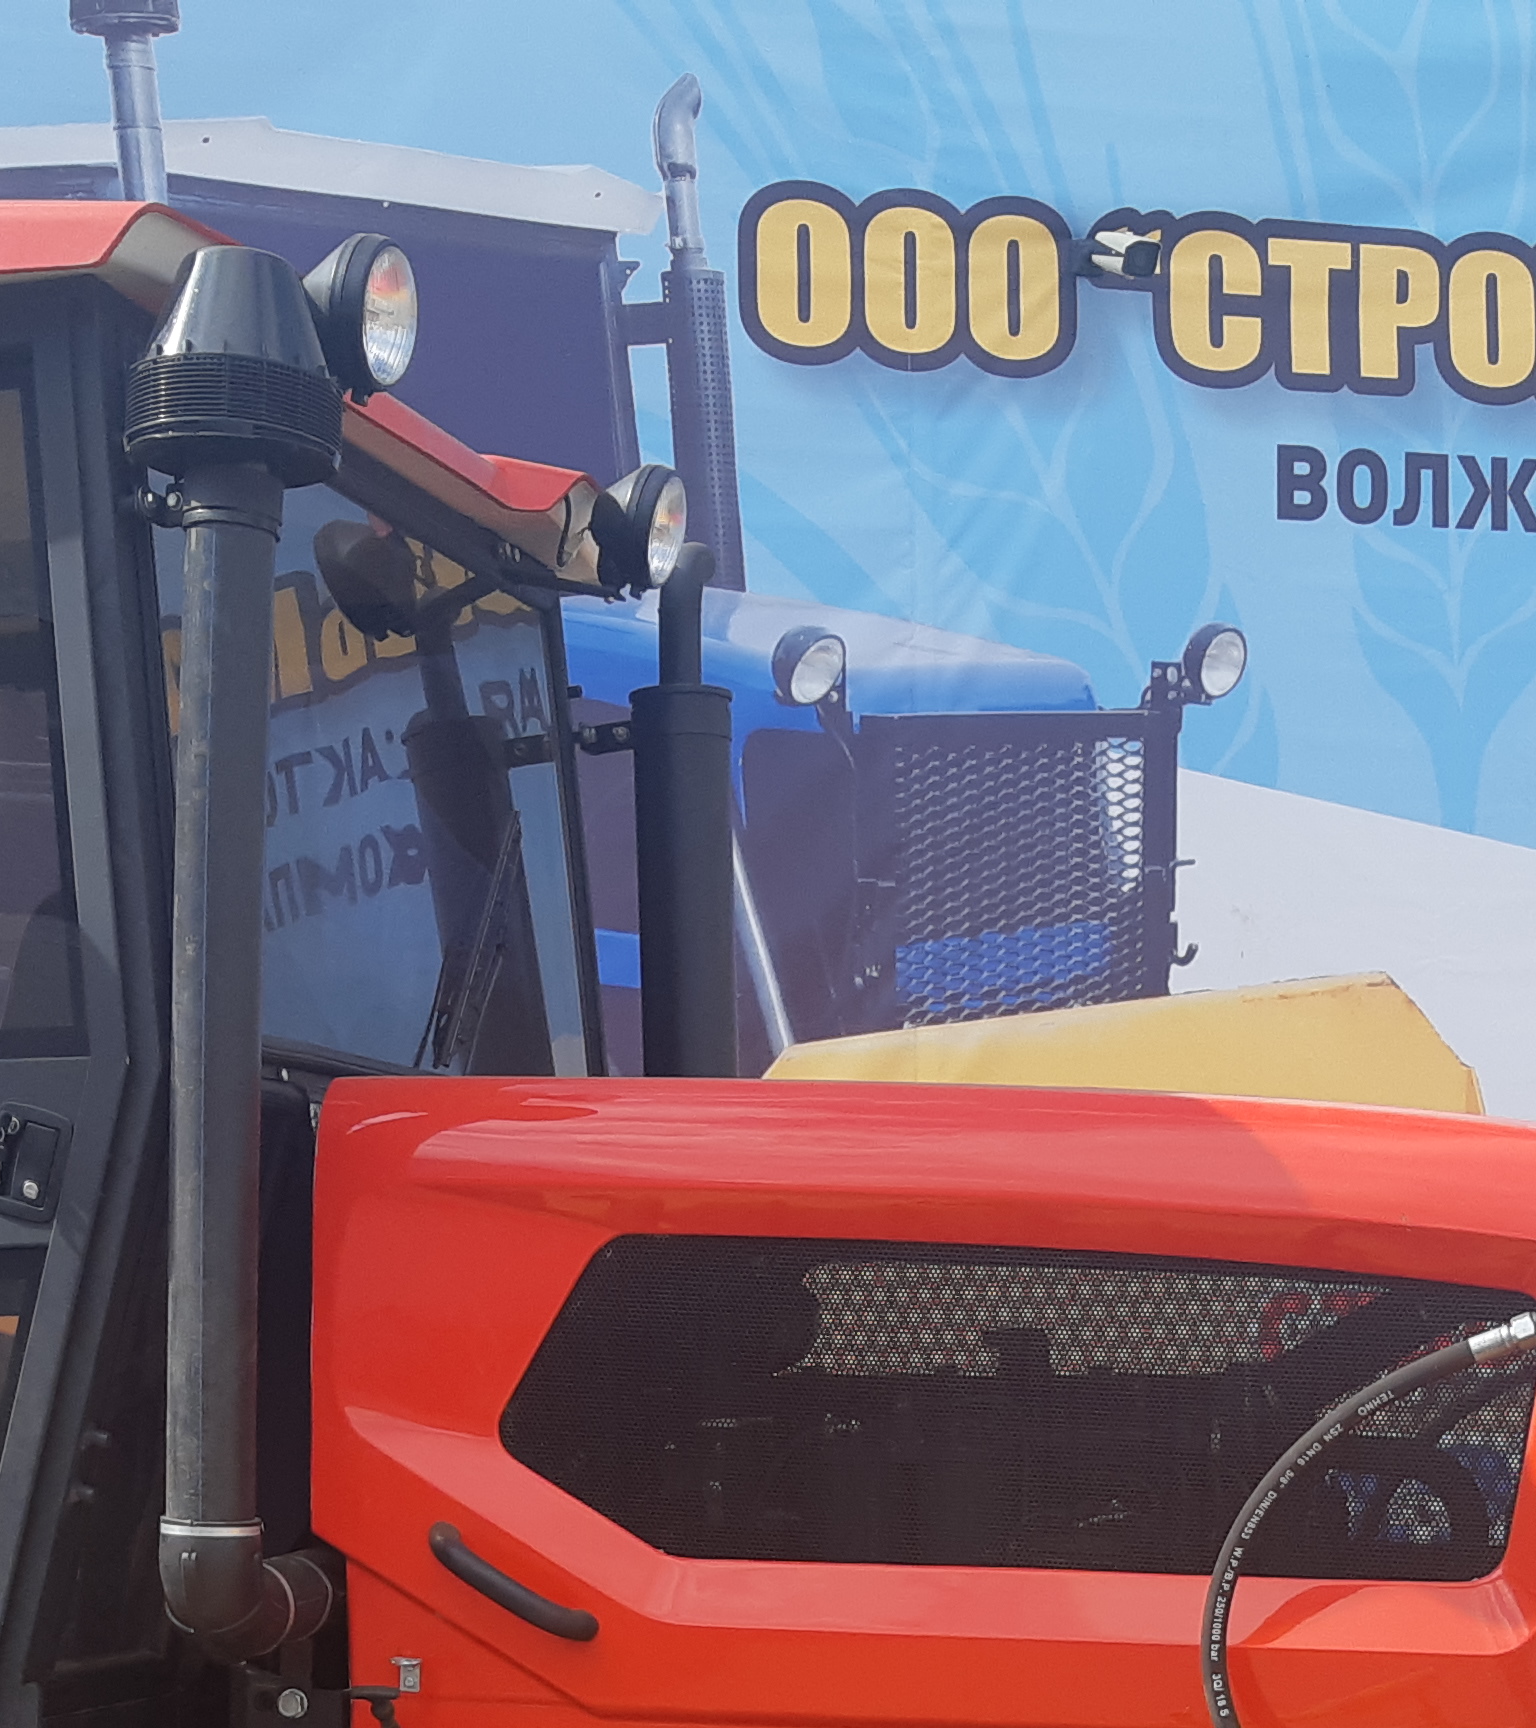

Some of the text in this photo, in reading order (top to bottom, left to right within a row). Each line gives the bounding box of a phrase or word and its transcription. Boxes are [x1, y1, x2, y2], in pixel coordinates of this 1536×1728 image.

[754, 197, 1062, 362] ООО
[1357, 1390, 1395, 1417] TEHNO
[1322, 1423, 1344, 1443] 2SN
[1296, 1441, 1323, 1467] DN16
[1210, 1644, 1221, 1662] bar
